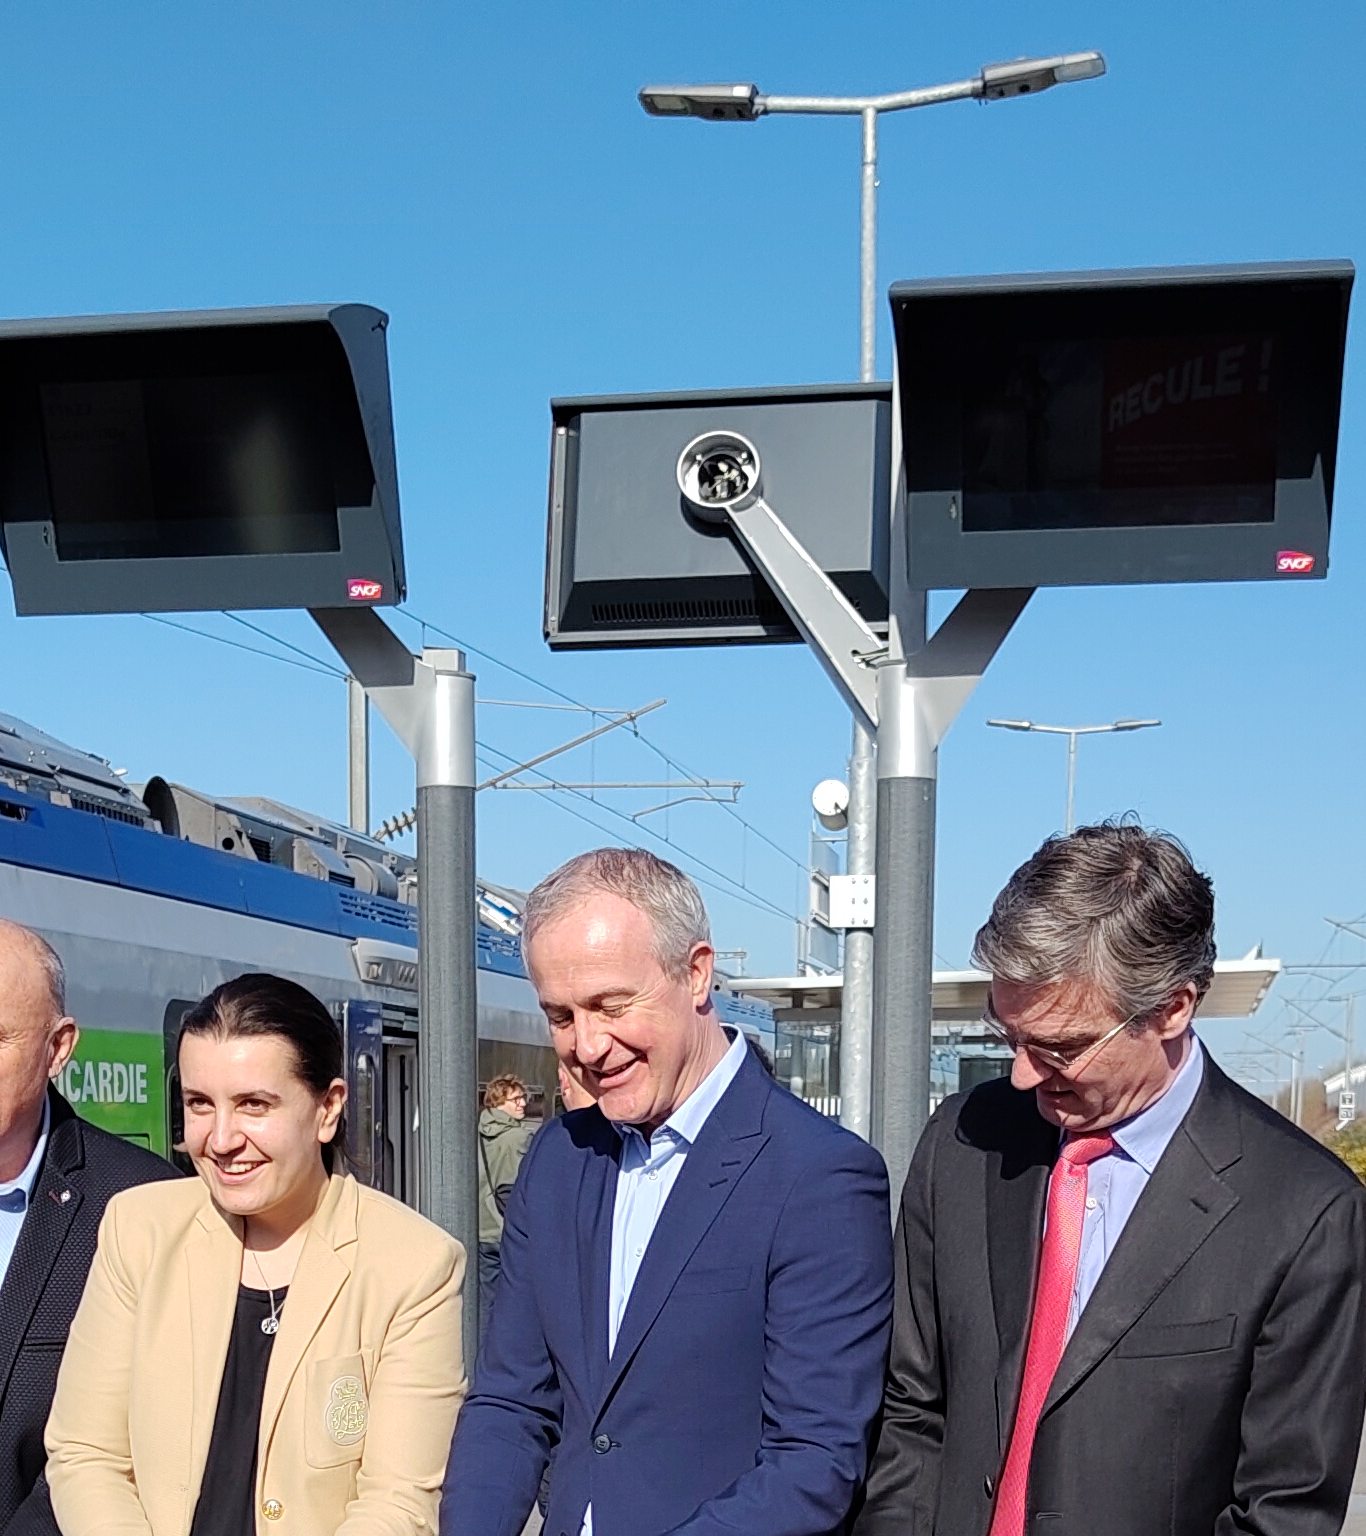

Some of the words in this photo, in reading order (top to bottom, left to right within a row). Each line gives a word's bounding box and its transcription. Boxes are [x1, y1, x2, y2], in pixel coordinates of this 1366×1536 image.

[1108, 345, 1245, 432] RECULE
[1278, 557, 1313, 570] SNCF
[350, 584, 382, 597] SNCF
[52, 1059, 148, 1104] ICARDIE
